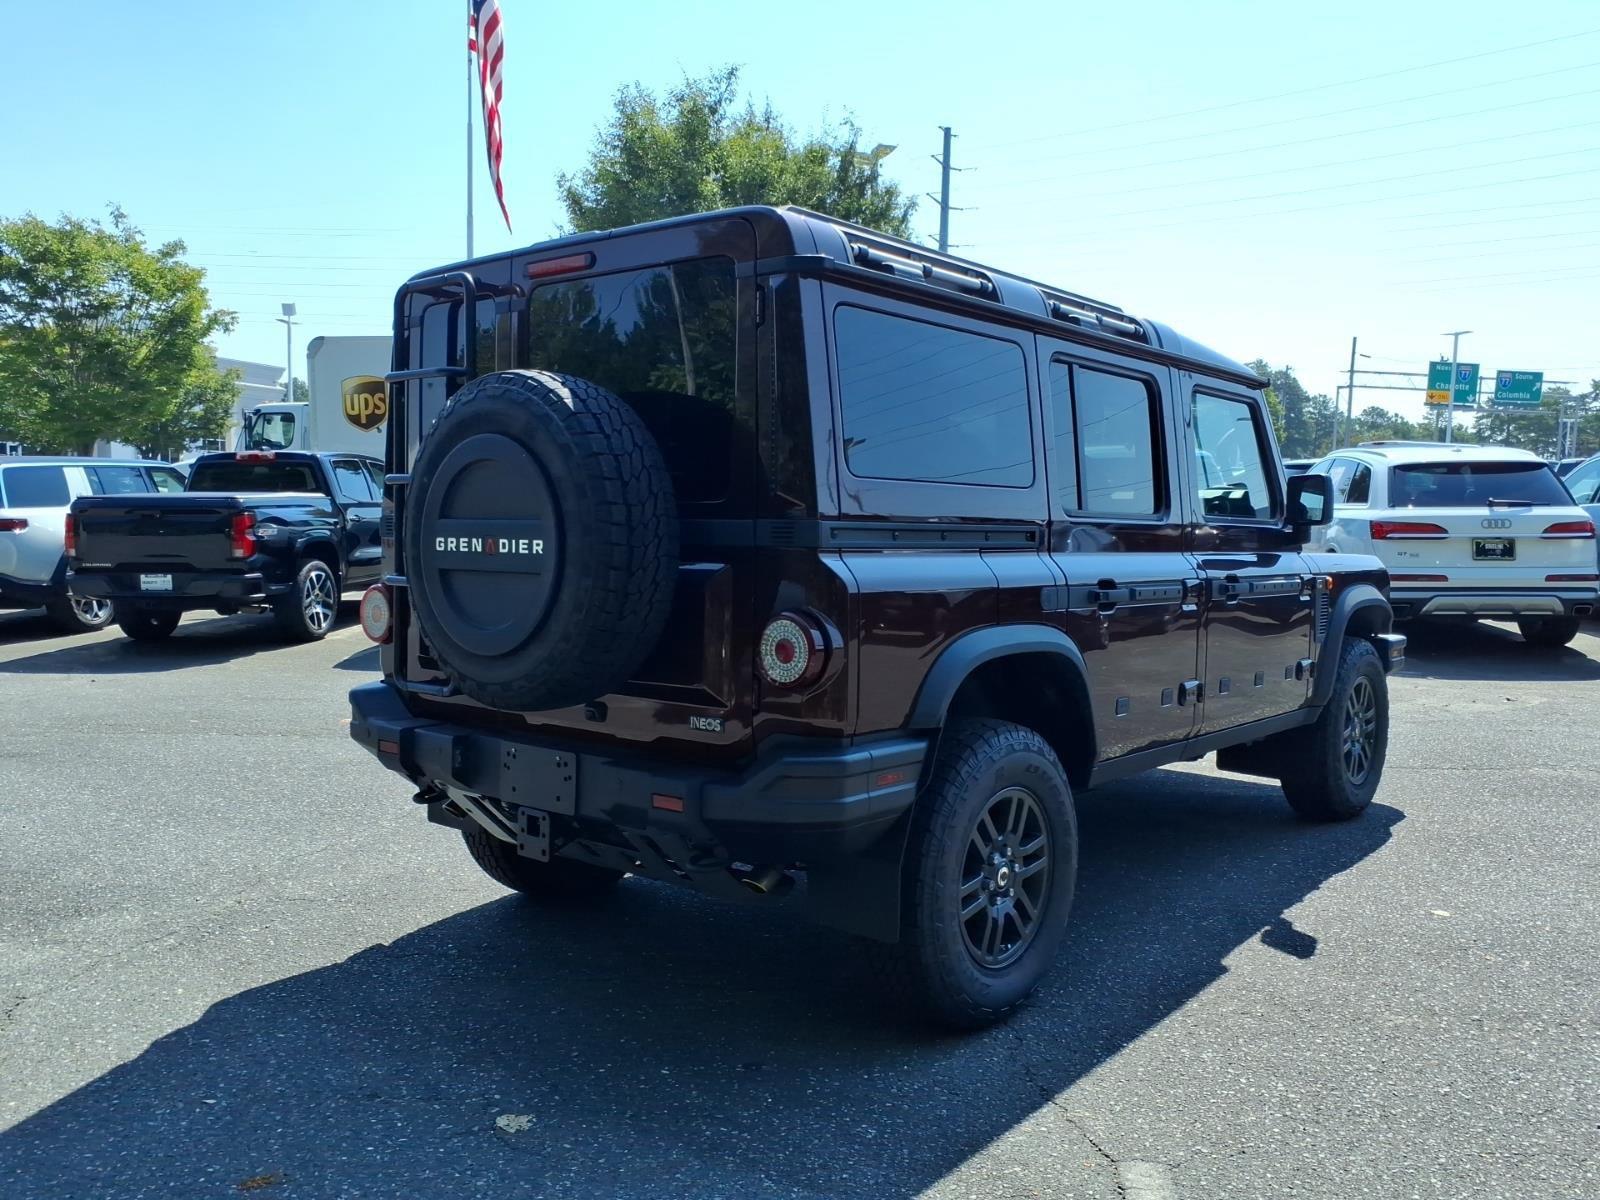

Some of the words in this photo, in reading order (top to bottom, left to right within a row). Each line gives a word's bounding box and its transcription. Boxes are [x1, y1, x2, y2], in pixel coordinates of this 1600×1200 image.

[1435, 382, 1470, 391] Chaotte
[1497, 391, 1530, 399] Columbia
[345, 392, 386, 424] ups
[435, 536, 544, 555] GRENADIER
[689, 716, 721, 732] INEOS
